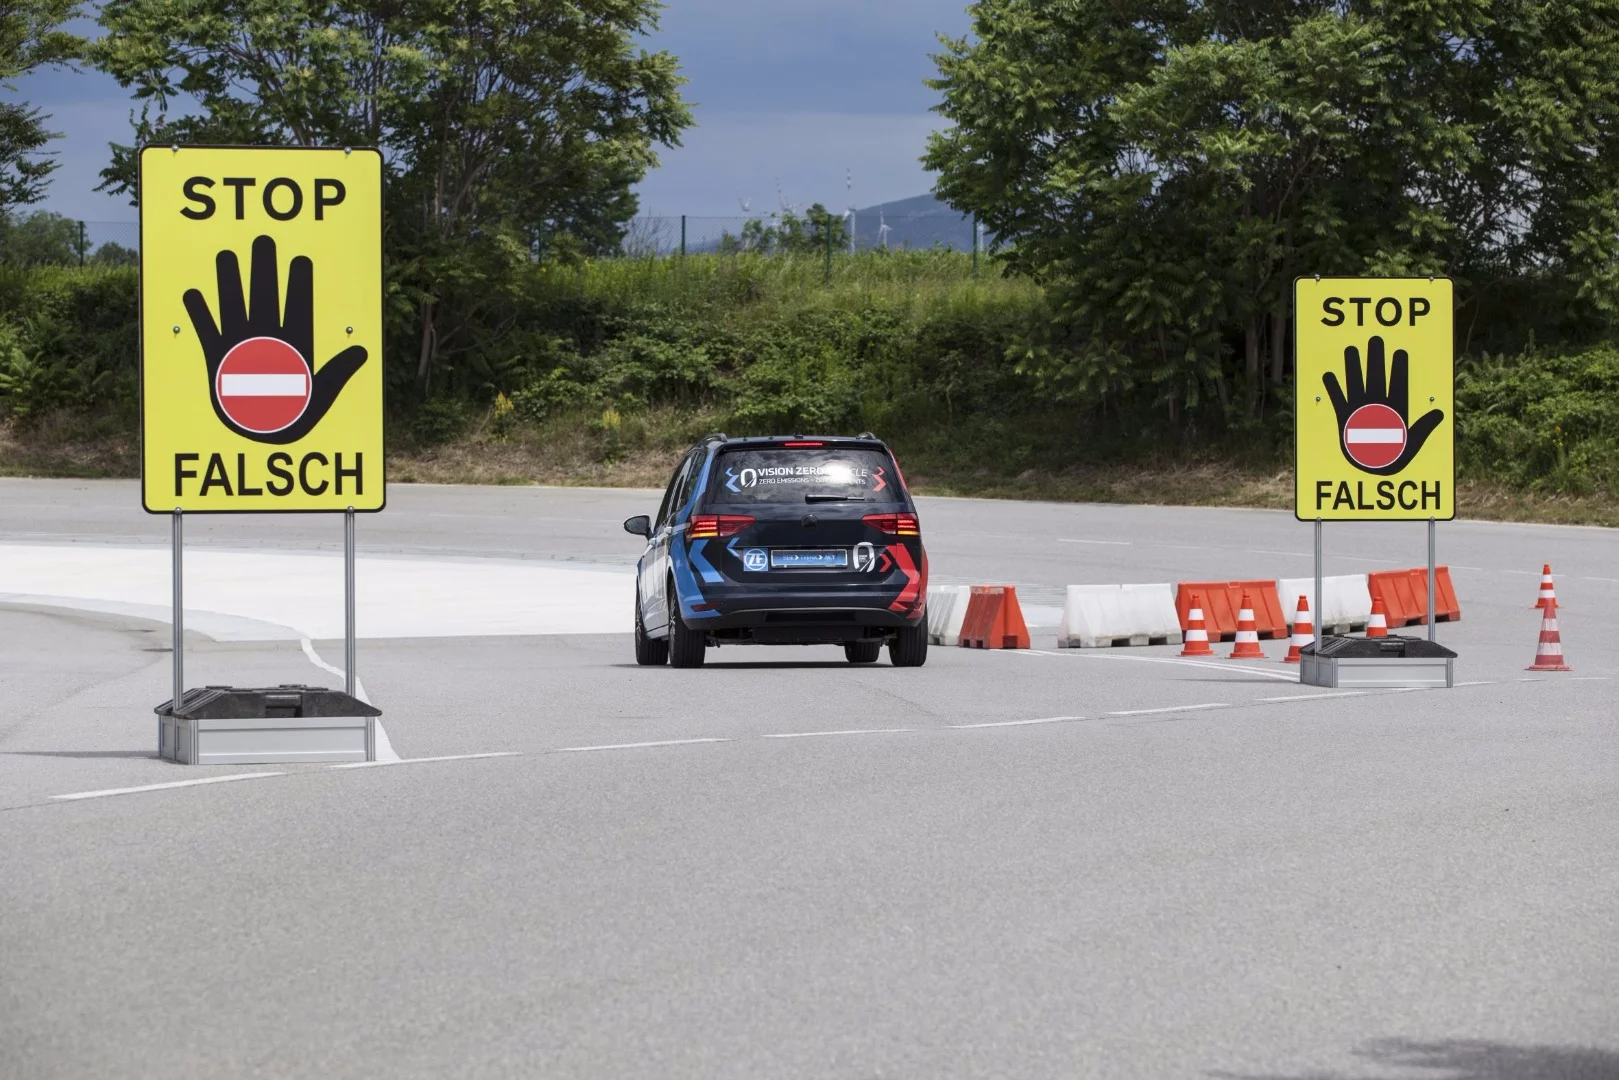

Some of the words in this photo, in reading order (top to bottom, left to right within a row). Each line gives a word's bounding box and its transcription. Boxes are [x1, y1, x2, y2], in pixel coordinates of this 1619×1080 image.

[179, 175, 347, 222] STOP
[1320, 296, 1431, 327] STOP
[174, 451, 364, 497] FALSCH
[757, 467, 794, 477] VISION
[795, 466, 825, 476] ZERO
[1315, 480, 1441, 511] FALSCH
[746, 553, 766, 566] ZF
